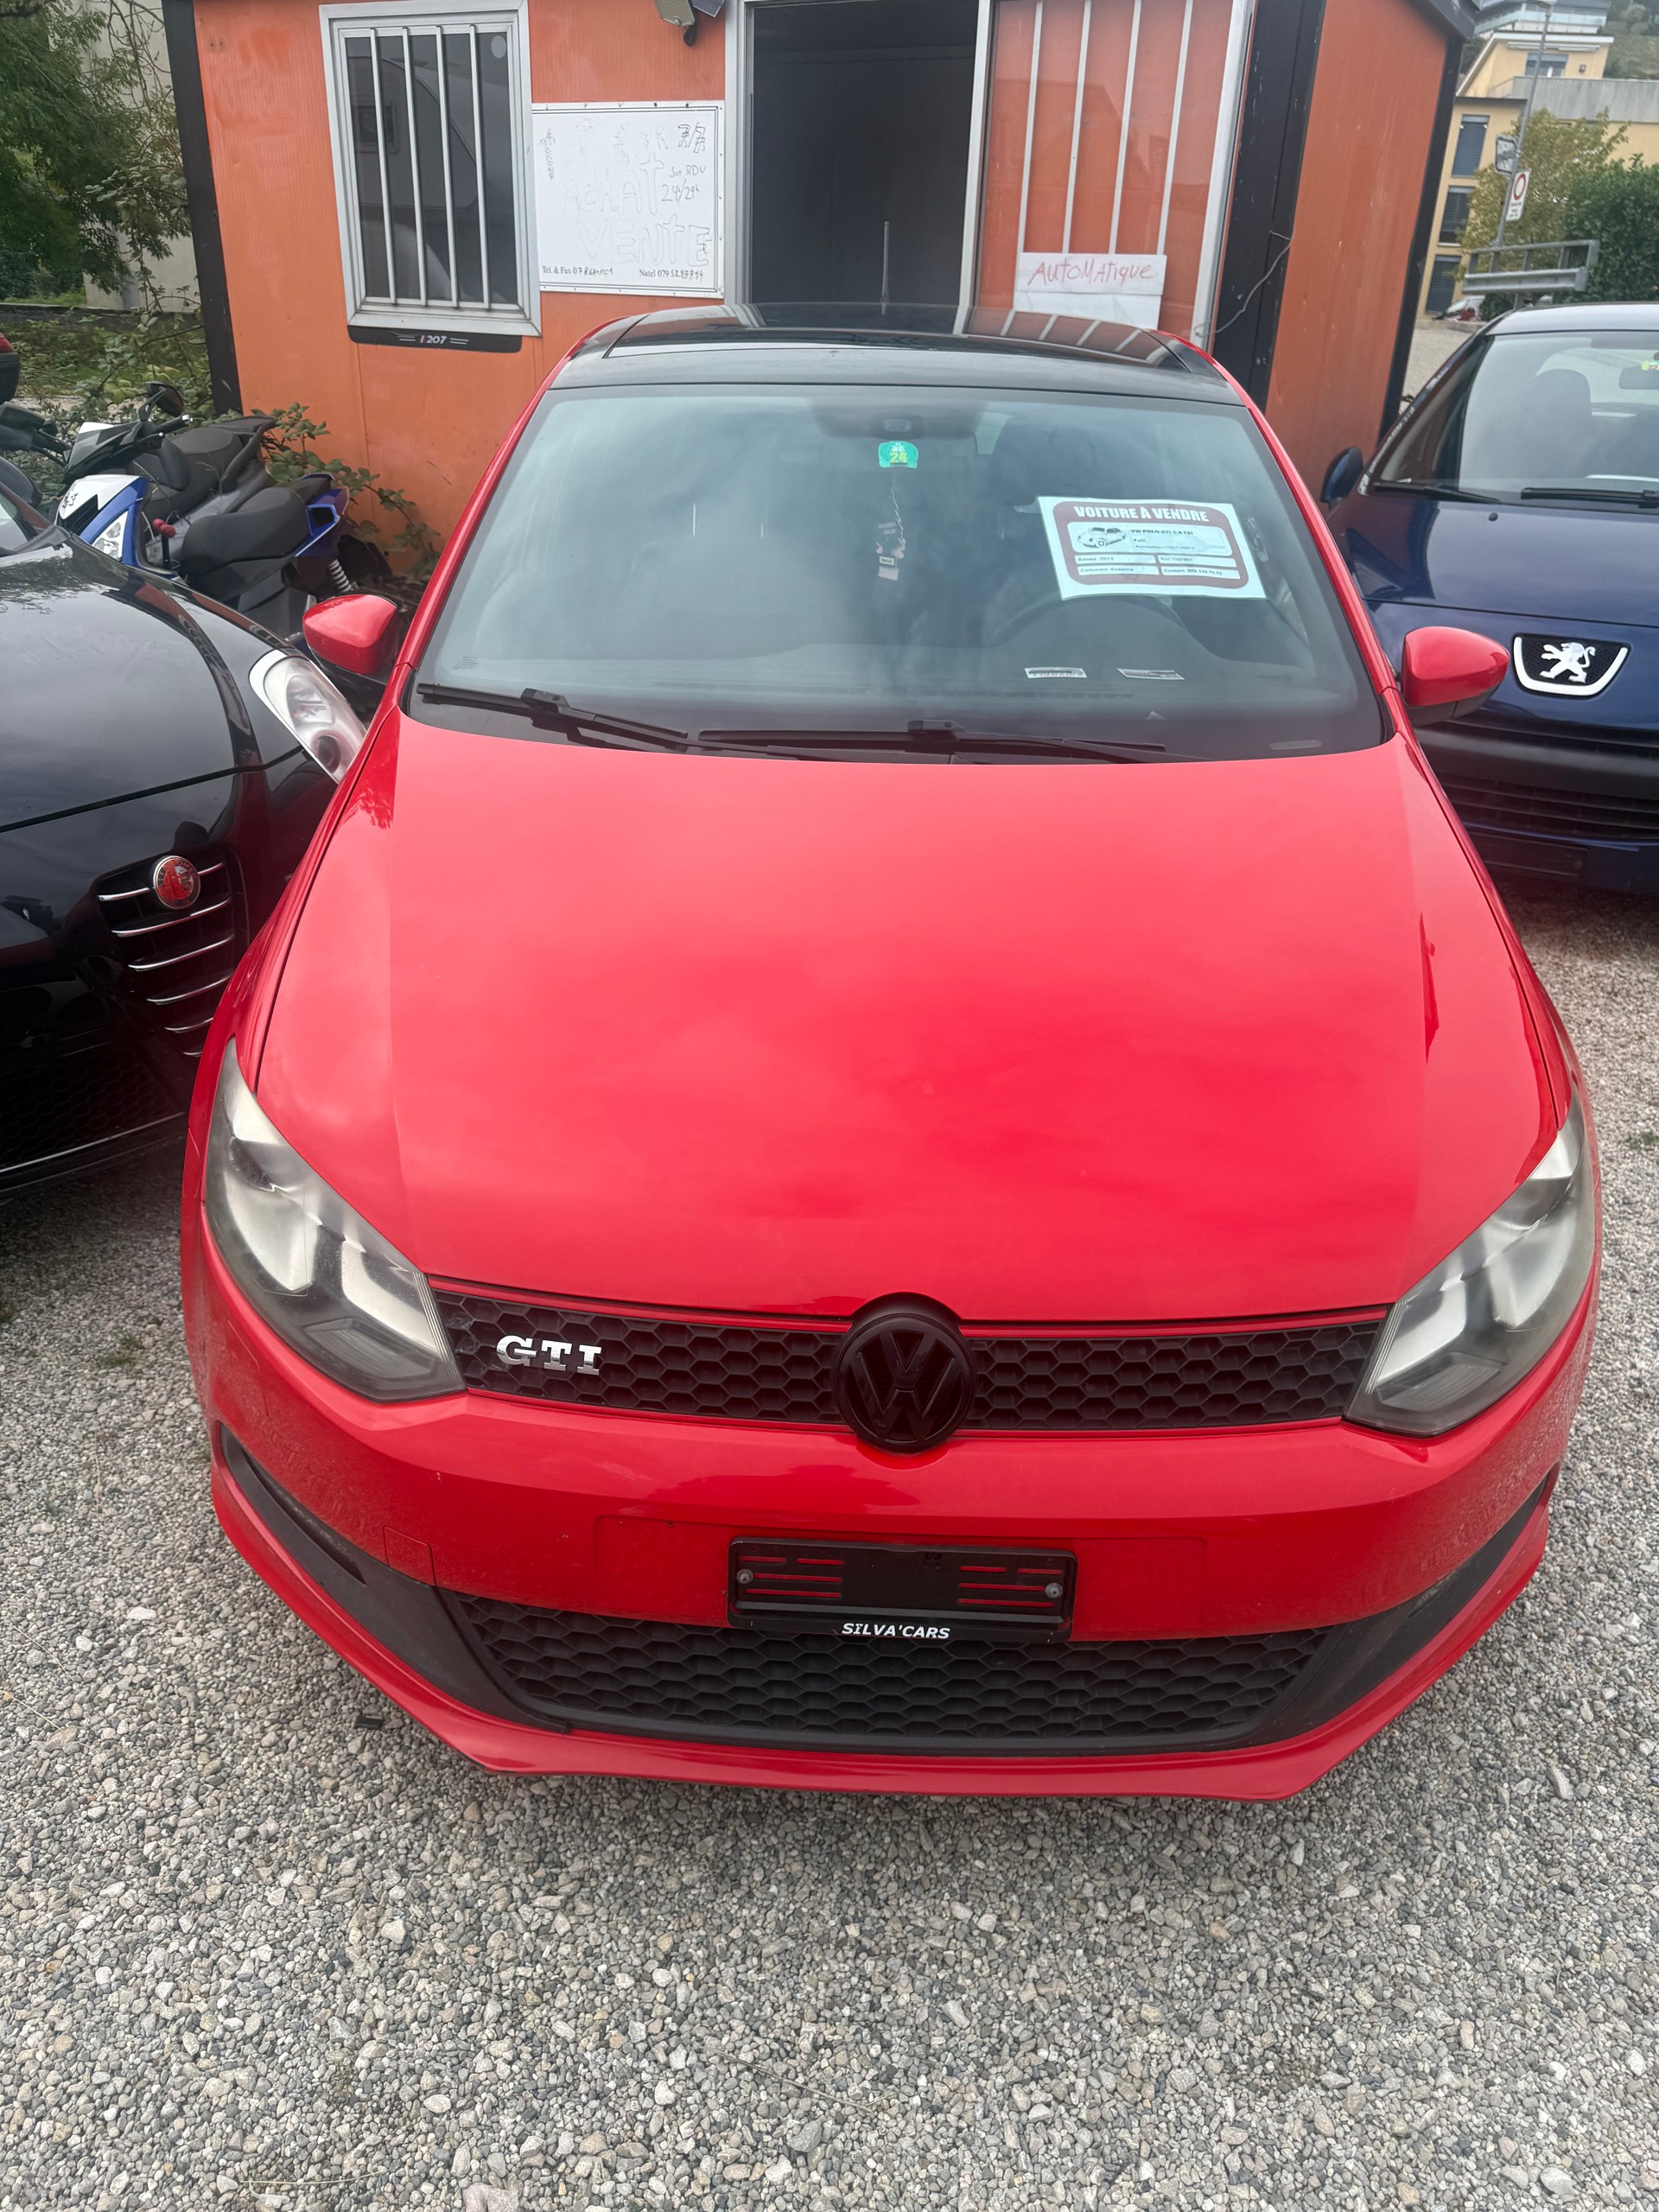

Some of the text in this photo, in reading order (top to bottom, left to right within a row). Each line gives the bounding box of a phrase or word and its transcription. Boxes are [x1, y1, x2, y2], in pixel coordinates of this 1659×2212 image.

[561, 266, 571, 275] Fax
[639, 269, 656, 277] Natel
[426, 334, 448, 344] 207
[1073, 505, 1210, 523] VOITURE À VENDRE
[496, 1334, 603, 1376] GTI
